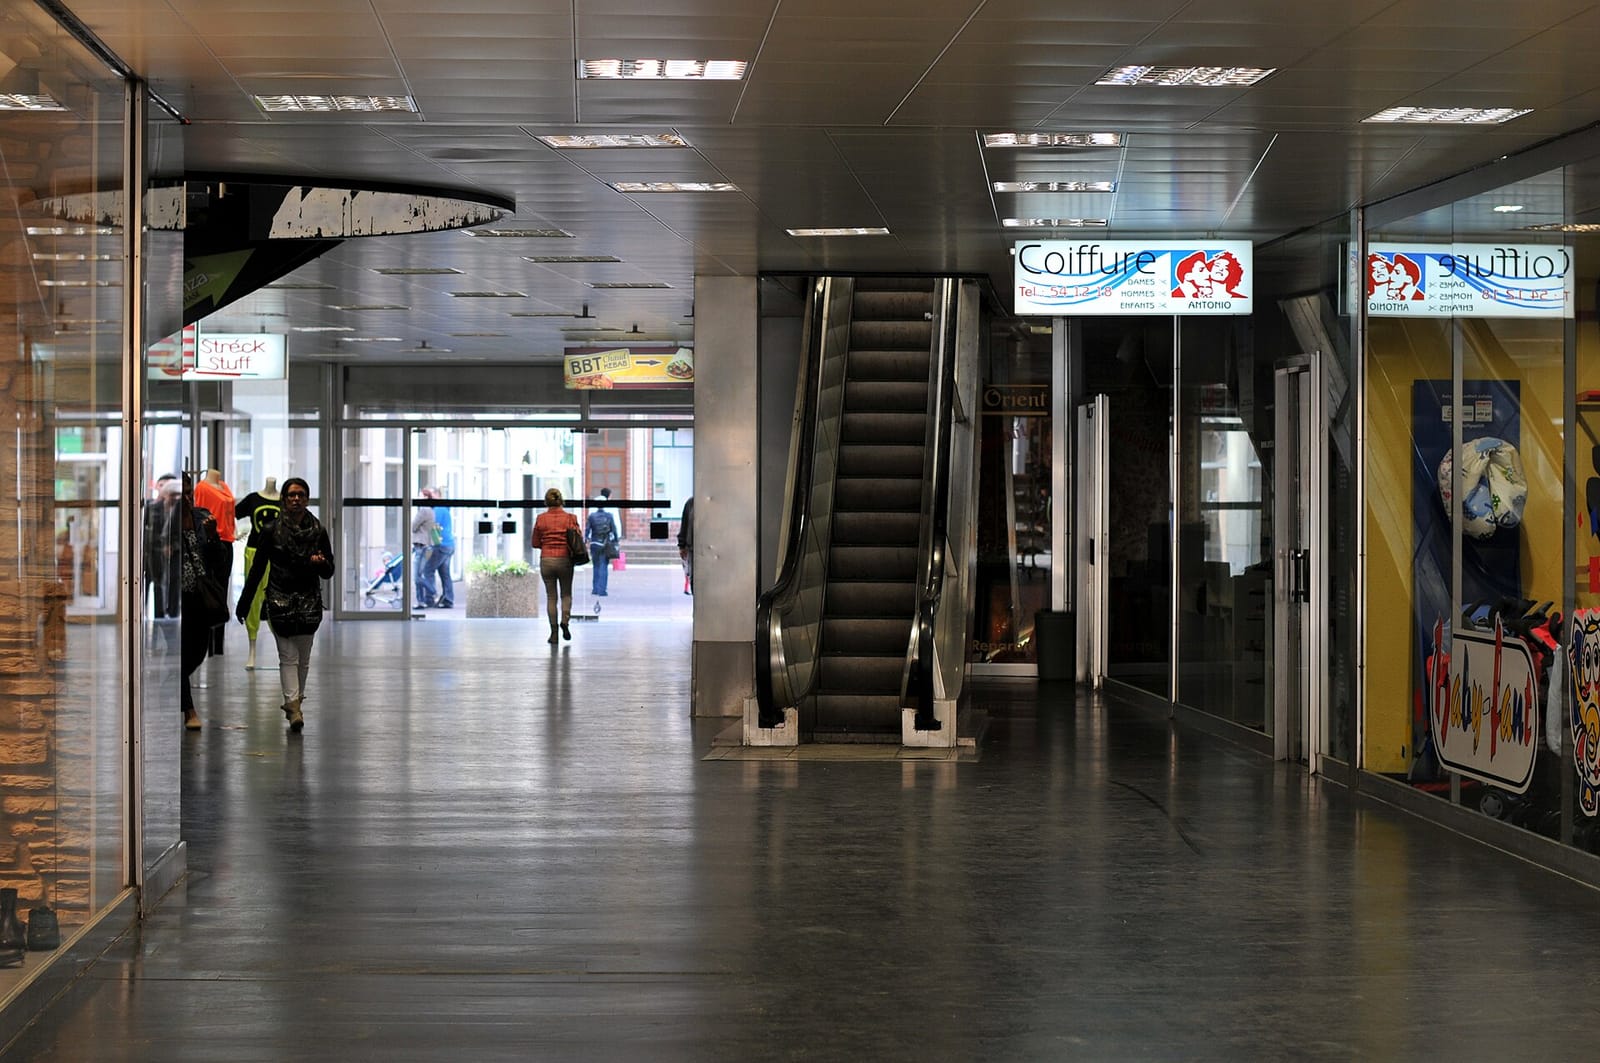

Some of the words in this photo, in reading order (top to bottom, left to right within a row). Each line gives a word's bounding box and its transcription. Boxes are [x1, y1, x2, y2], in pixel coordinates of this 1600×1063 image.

[1019, 244, 1156, 274] Coiffure
[1127, 278, 1155, 286] DAMES
[1050, 286, 1067, 297] 54
[1074, 286, 1089, 297] 12
[1096, 286, 1112, 297] 18
[1121, 290, 1155, 298] HOMMES
[1188, 301, 1232, 310] ANTONIO
[200, 338, 265, 354] Stréck
[209, 356, 251, 371] Stuff
[571, 357, 602, 375] BBT
[604, 360, 628, 369] KEBAB
[984, 388, 1048, 407] Orient
